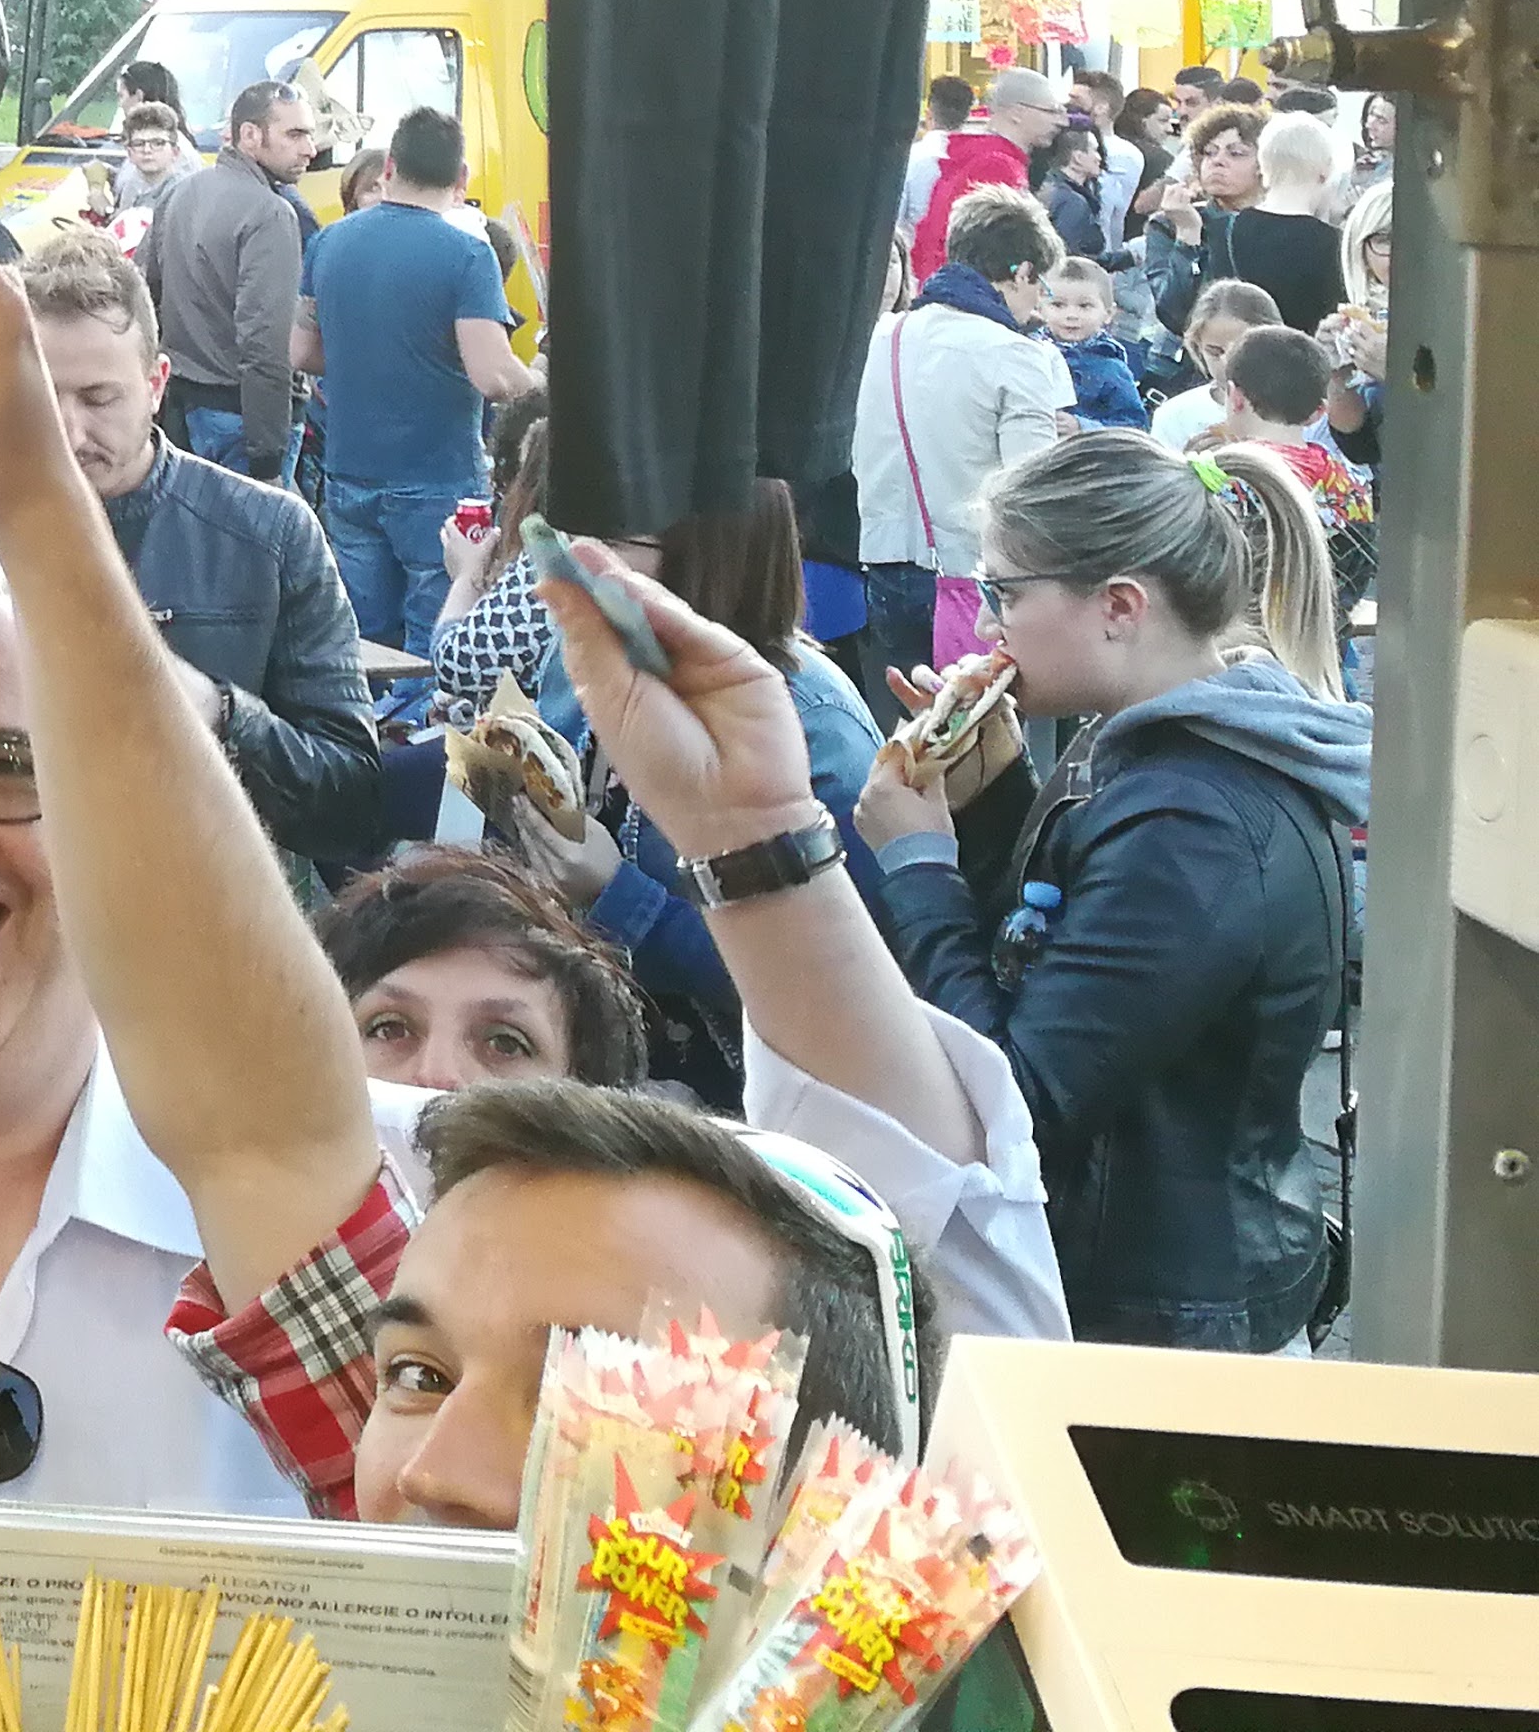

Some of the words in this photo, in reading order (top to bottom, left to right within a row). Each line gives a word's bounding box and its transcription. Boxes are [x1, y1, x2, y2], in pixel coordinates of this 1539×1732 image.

[1267, 1500, 1392, 1535] SMART
[592, 1538, 689, 1628] POWER
[608, 1518, 688, 1592] SOUR
[308, 1600, 400, 1618] ALLERGIE
[405, 1608, 420, 1619] O
[810, 1575, 895, 1674] POWER
